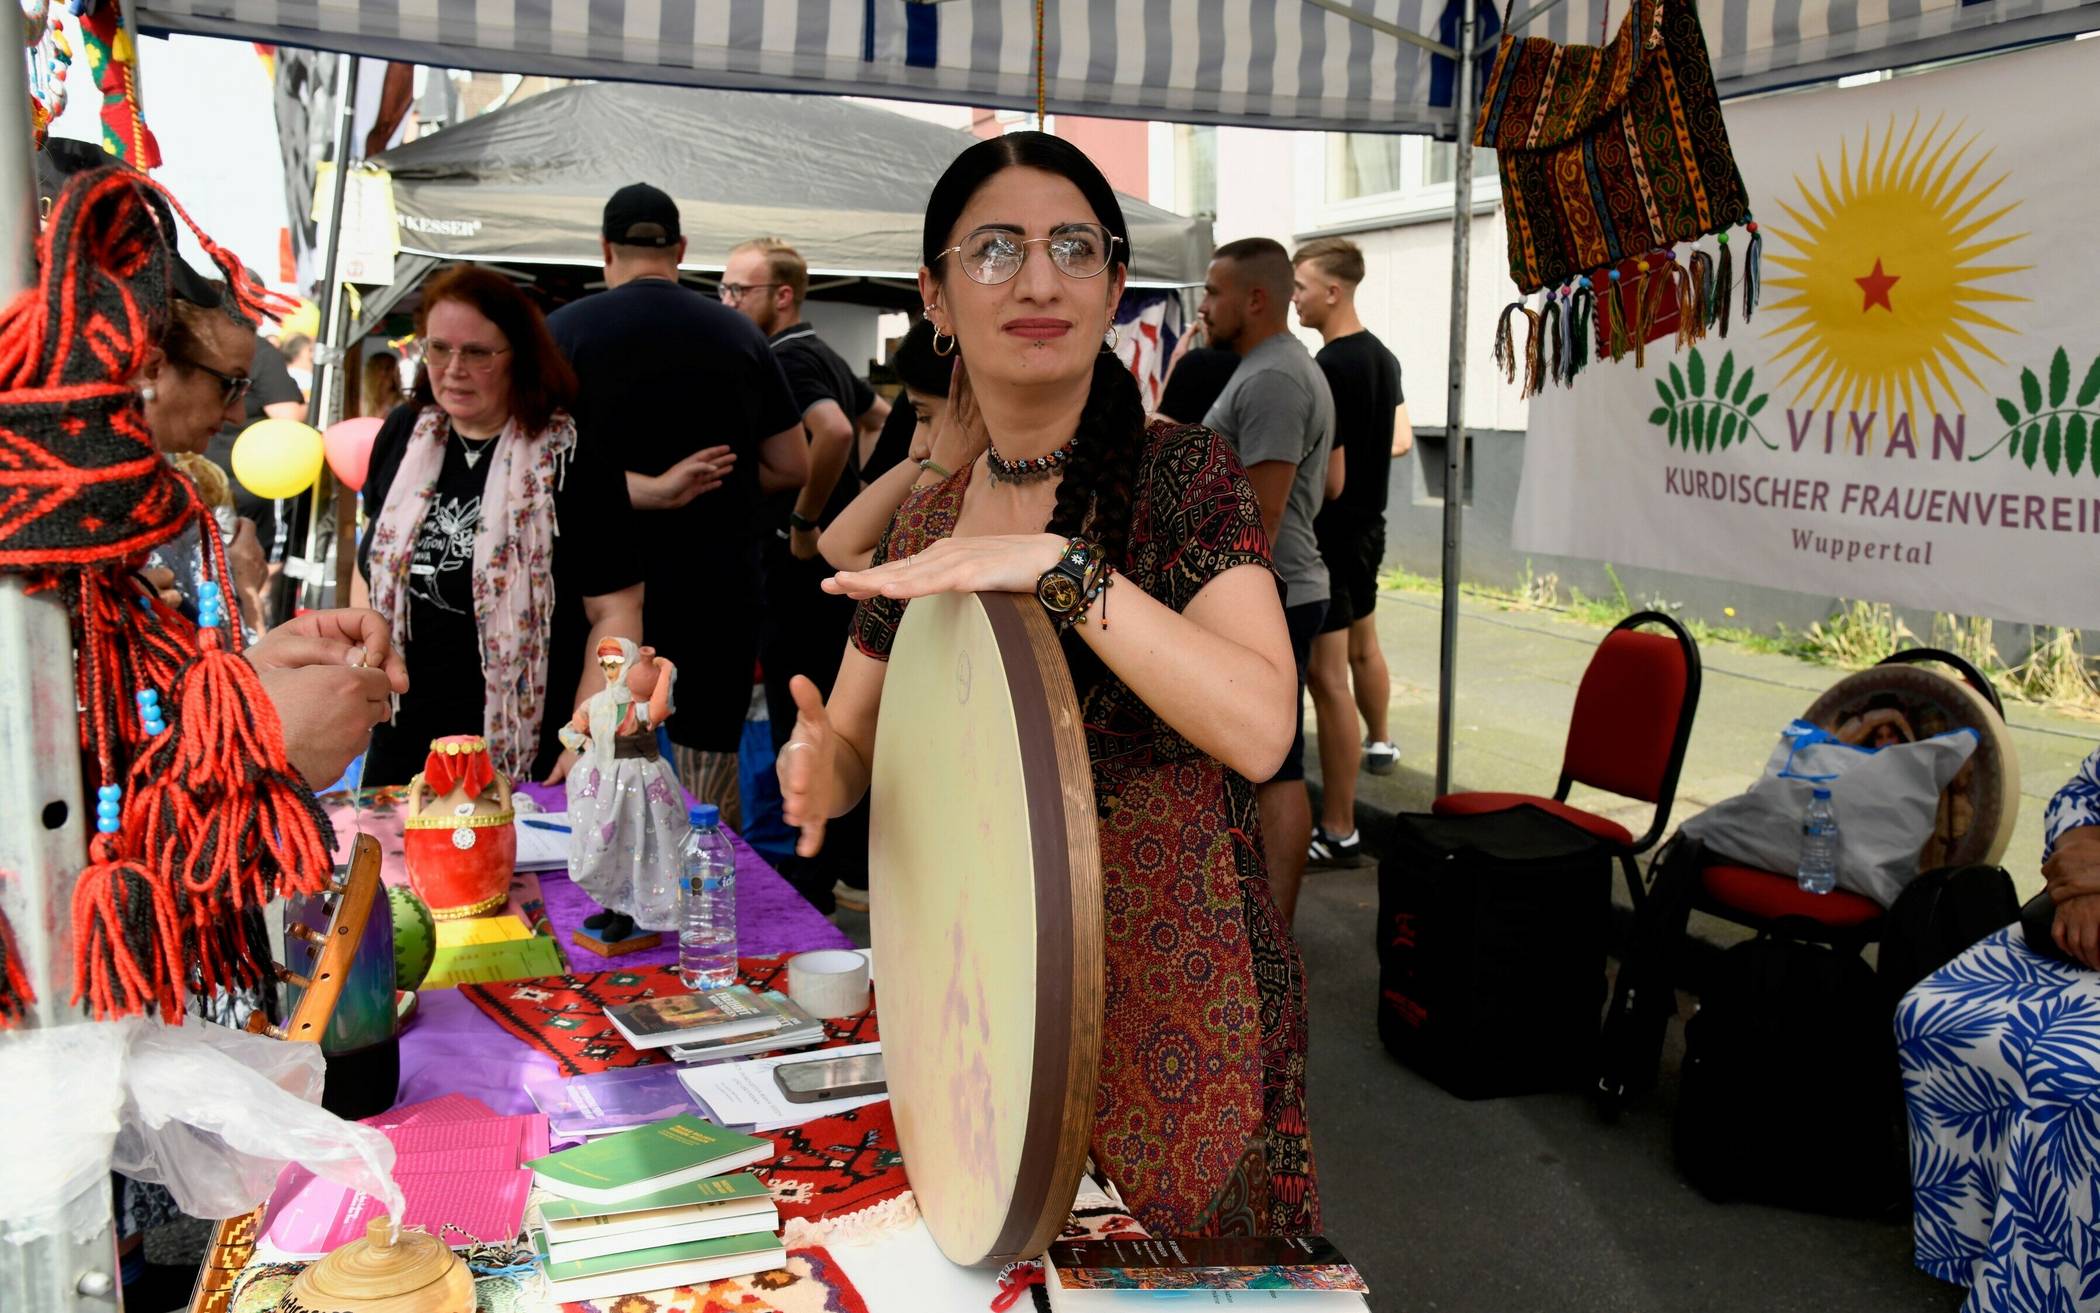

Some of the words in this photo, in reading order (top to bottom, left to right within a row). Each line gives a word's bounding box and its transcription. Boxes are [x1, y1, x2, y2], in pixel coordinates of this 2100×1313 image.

[1787, 408, 1966, 462] VIYAN
[1665, 465, 1830, 512] KURDISCHER
[1791, 527, 1932, 566] Wuppertal
